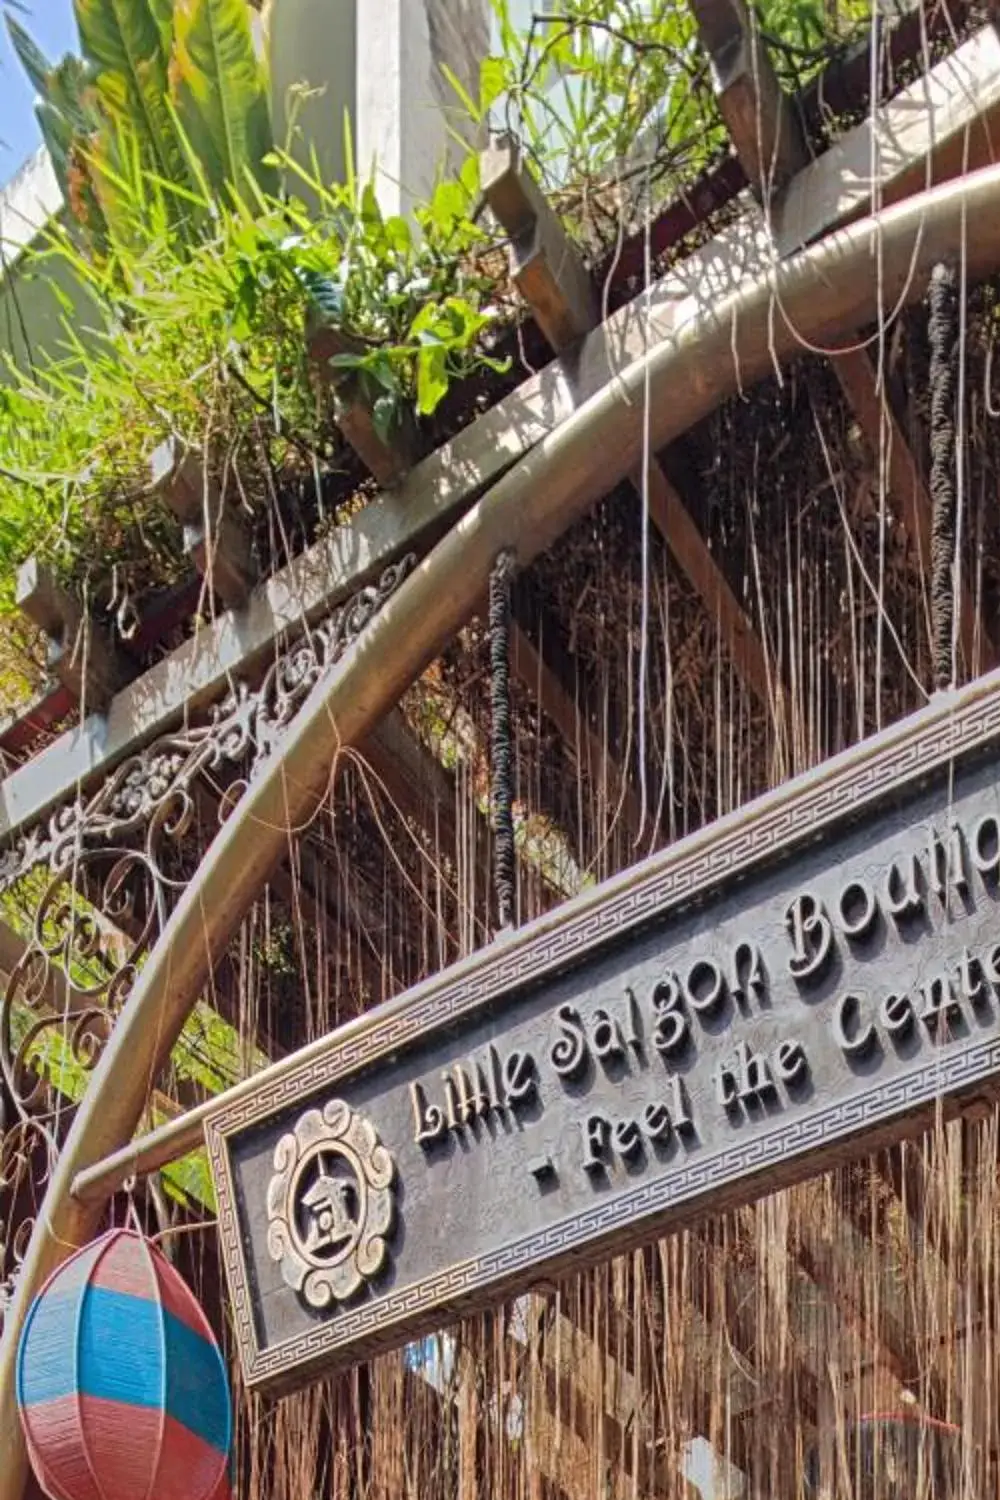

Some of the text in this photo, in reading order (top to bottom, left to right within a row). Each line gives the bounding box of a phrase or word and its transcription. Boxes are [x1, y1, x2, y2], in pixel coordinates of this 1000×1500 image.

[409, 1043, 533, 1143] Little
[551, 942, 761, 1074] Saigon
[583, 1072, 690, 1171] Feel
[715, 1038, 807, 1106] the
